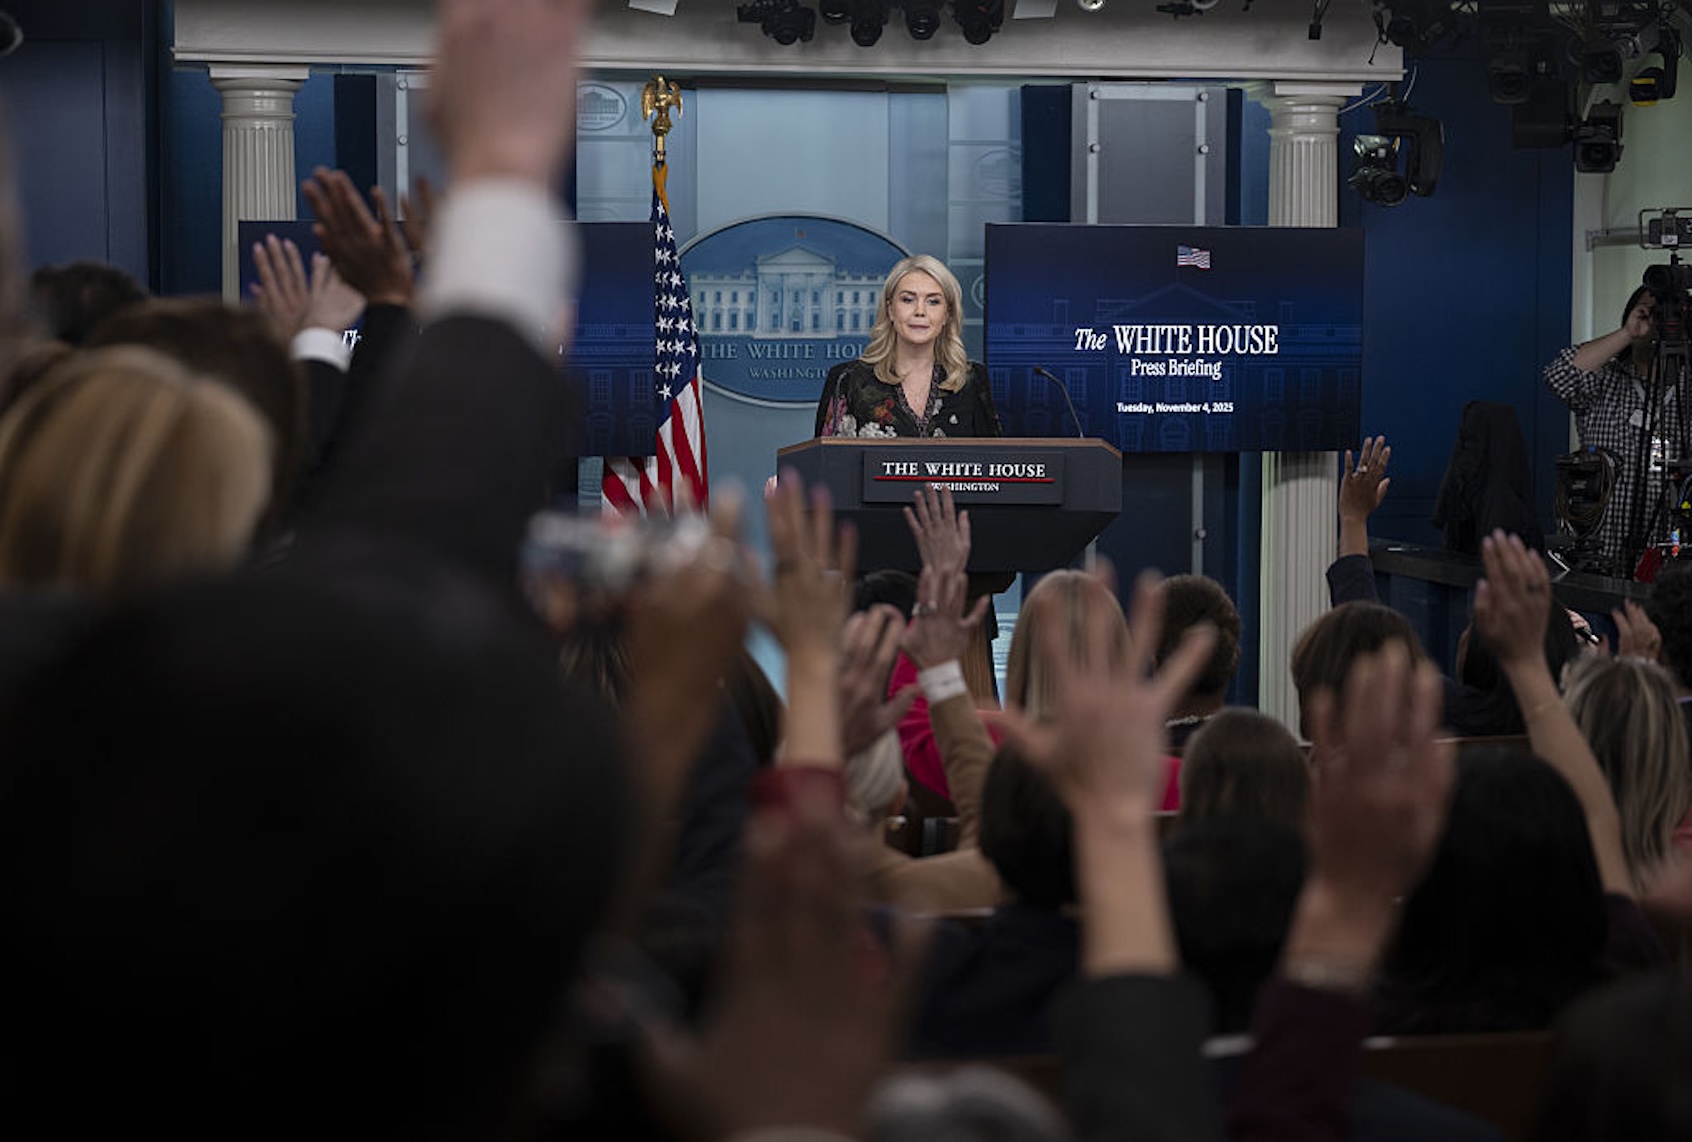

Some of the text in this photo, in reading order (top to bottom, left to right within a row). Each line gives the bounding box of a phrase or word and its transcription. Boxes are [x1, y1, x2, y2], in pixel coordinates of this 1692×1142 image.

[1074, 325, 1279, 354] The WHITE HOUSE
[699, 343, 863, 359] THE WHITE HOU
[750, 367, 829, 379] WASHINGT
[1131, 358, 1223, 381] Press Briefing
[1116, 402, 1234, 414] Tuesday, November 4, 2025
[882, 462, 1046, 478] THE WHITE HOUSE
